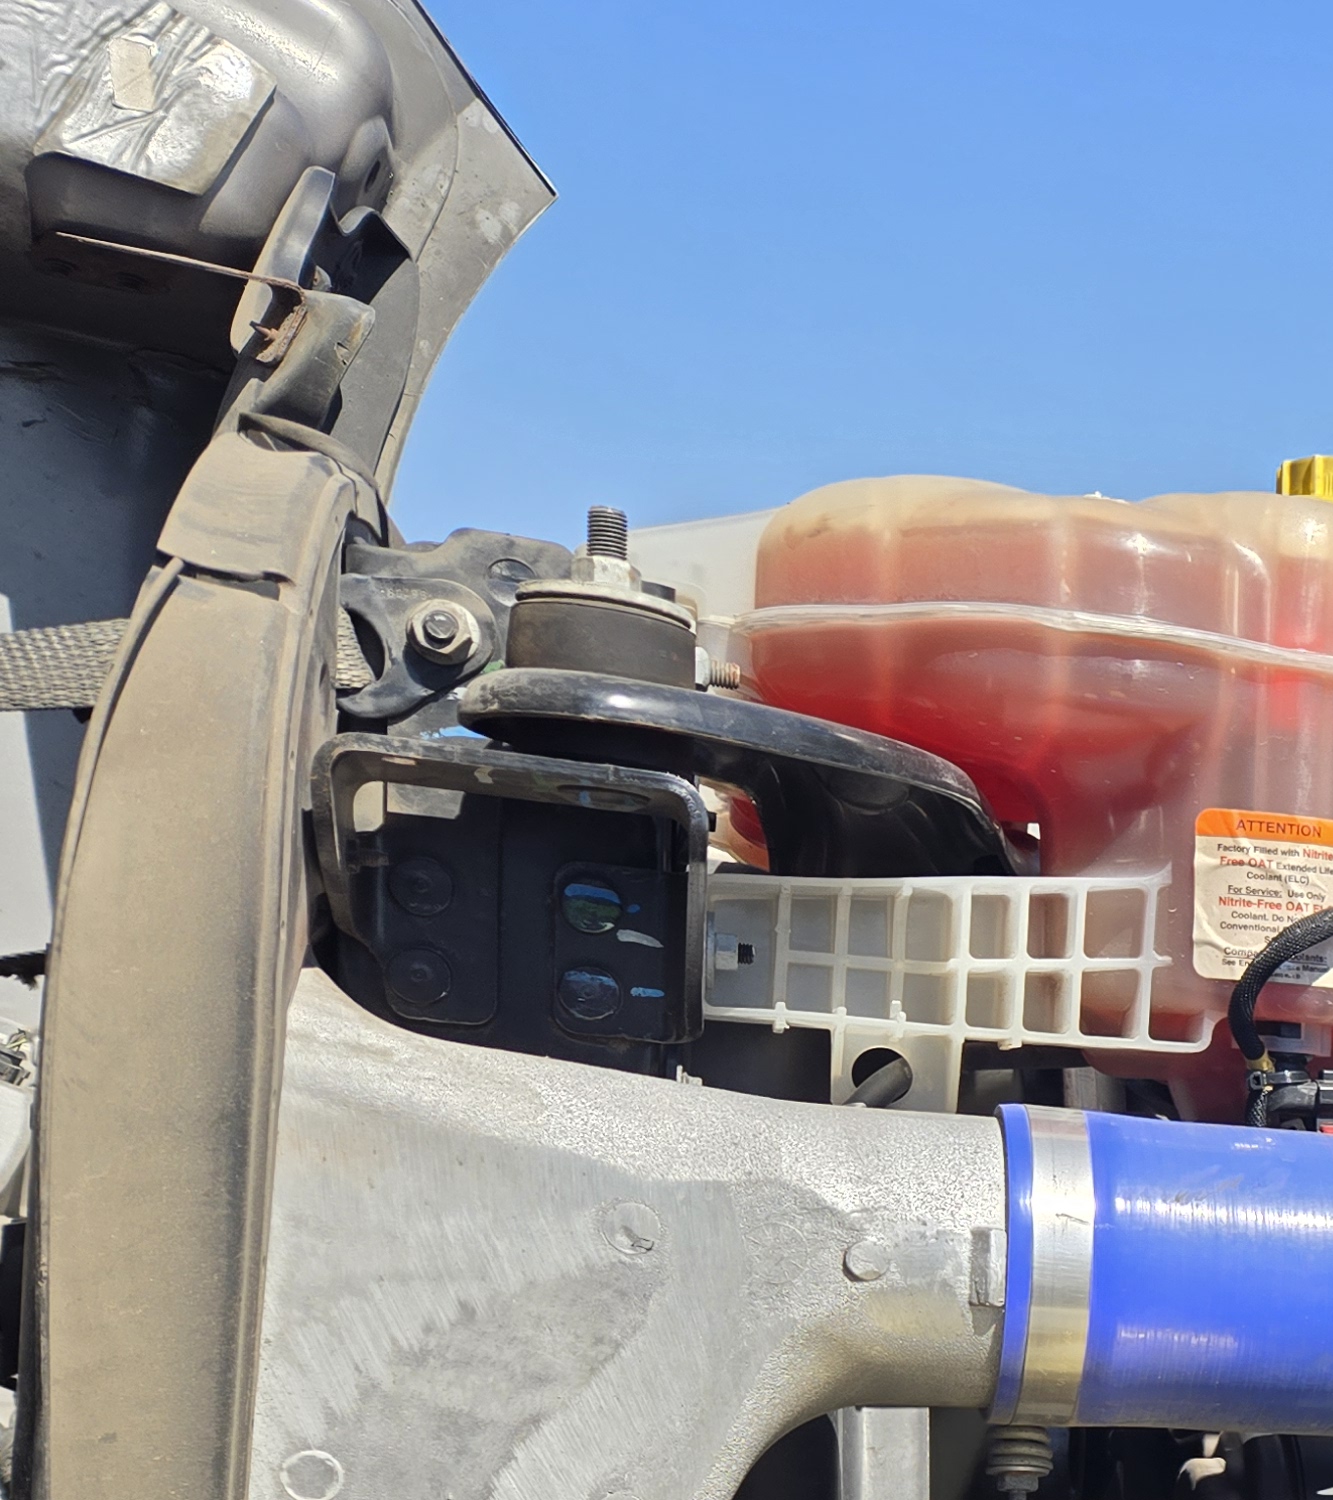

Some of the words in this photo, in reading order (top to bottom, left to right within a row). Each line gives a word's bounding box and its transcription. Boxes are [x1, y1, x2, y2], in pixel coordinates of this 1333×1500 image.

[1236, 819, 1322, 838] ATTENTION
[1217, 844, 1250, 854] Factory
[1253, 846, 1278, 856] Filled
[1280, 849, 1300, 857] with
[1220, 857, 1245, 867] Free
[1247, 859, 1273, 869] OAT
[1276, 863, 1317, 874] Extended
[1247, 872, 1282, 882] Coolant
[1284, 875, 1310, 885] (ELC)
[1228, 885, 1243, 894] For
[1245, 887, 1282, 897] Service:
[1287, 890, 1304, 899] Use
[1306, 892, 1326, 902] Only
[1218, 896, 1282, 910] Nitrite-Free
[1286, 902, 1309, 912] OAT
[1272, 914, 1284, 923] Do
[1287, 915, 1300, 923] No
[1220, 921, 1280, 933] Conventional
